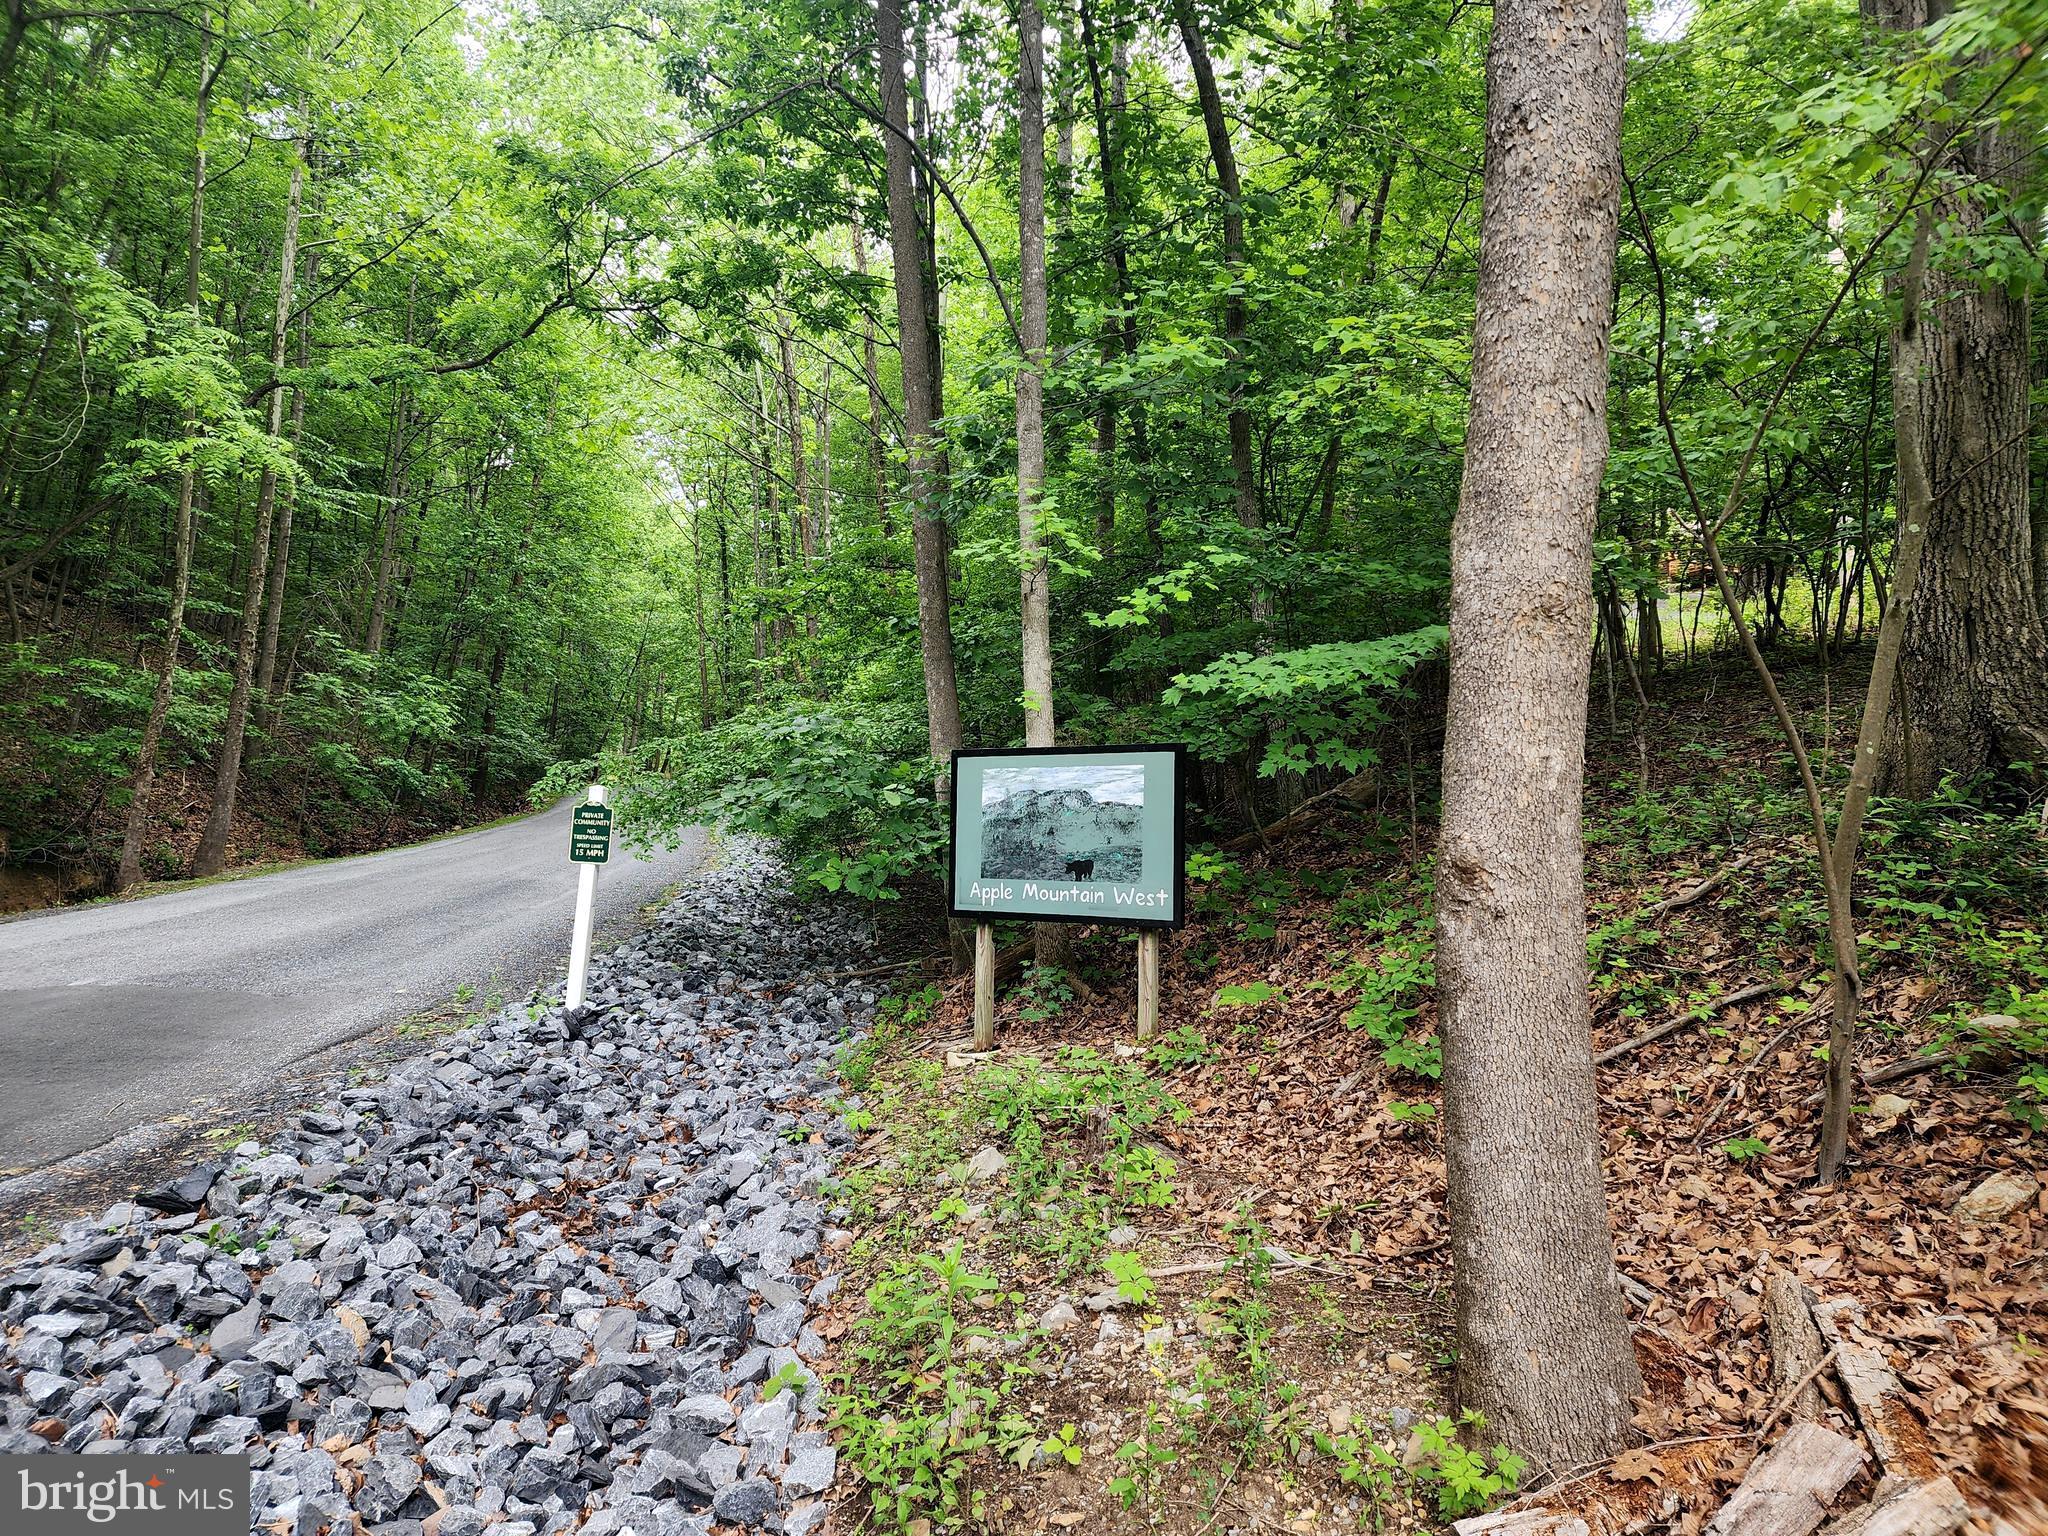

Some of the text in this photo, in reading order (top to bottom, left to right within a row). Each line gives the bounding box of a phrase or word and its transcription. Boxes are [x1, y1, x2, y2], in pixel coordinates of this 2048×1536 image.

[586, 849, 604, 857] MPH
[970, 882, 1168, 907] Apple Mountain West
